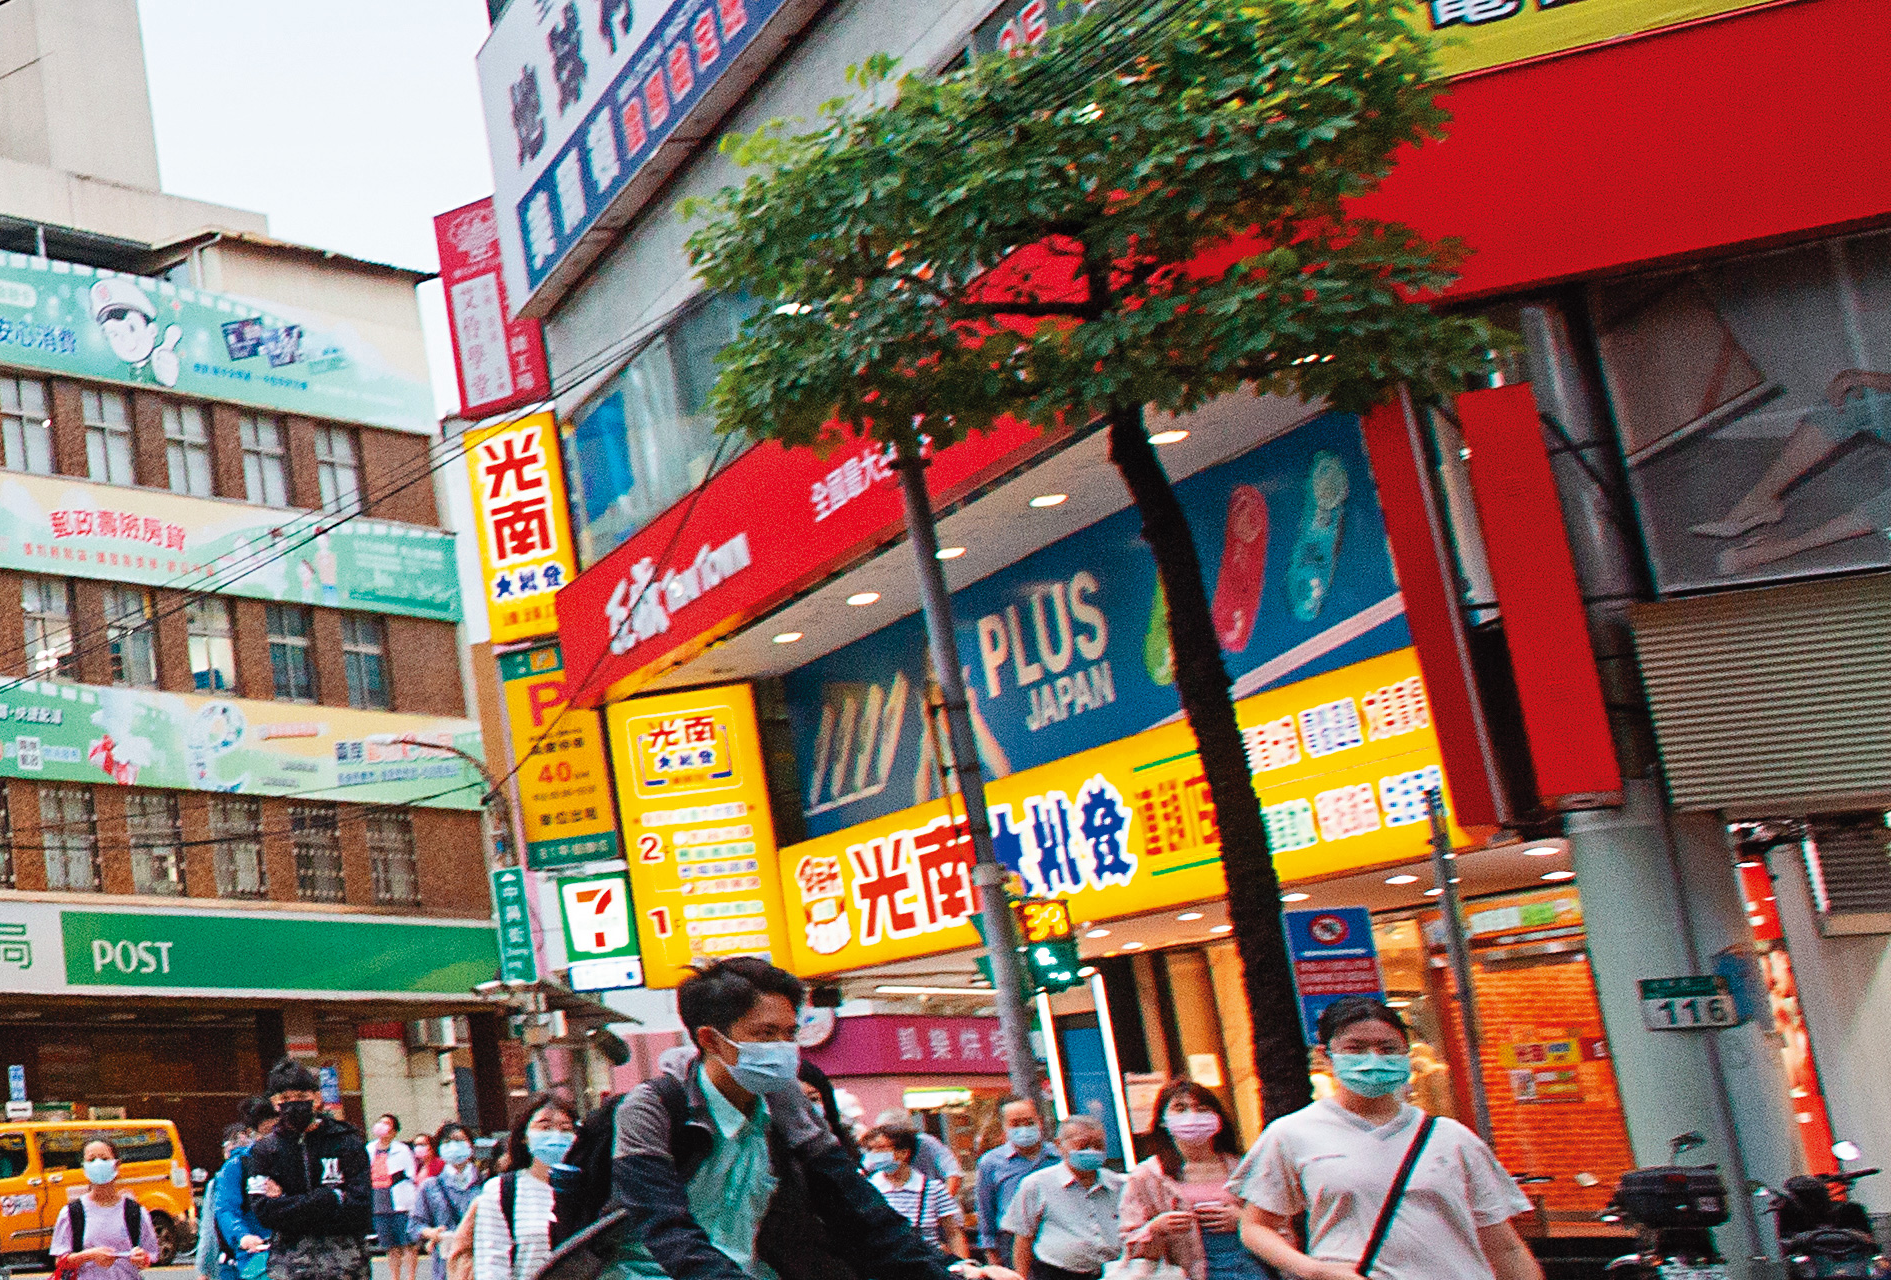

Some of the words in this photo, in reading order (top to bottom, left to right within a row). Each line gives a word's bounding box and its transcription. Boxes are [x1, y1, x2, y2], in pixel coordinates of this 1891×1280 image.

[484, 431, 552, 561] 光南
[977, 570, 1111, 699] PLUS
[1025, 664, 1117, 734] JAPAN
[647, 715, 716, 750] 光南
[538, 760, 571, 785] 40
[92, 938, 174, 976] POST
[1657, 999, 1727, 1025] 116
